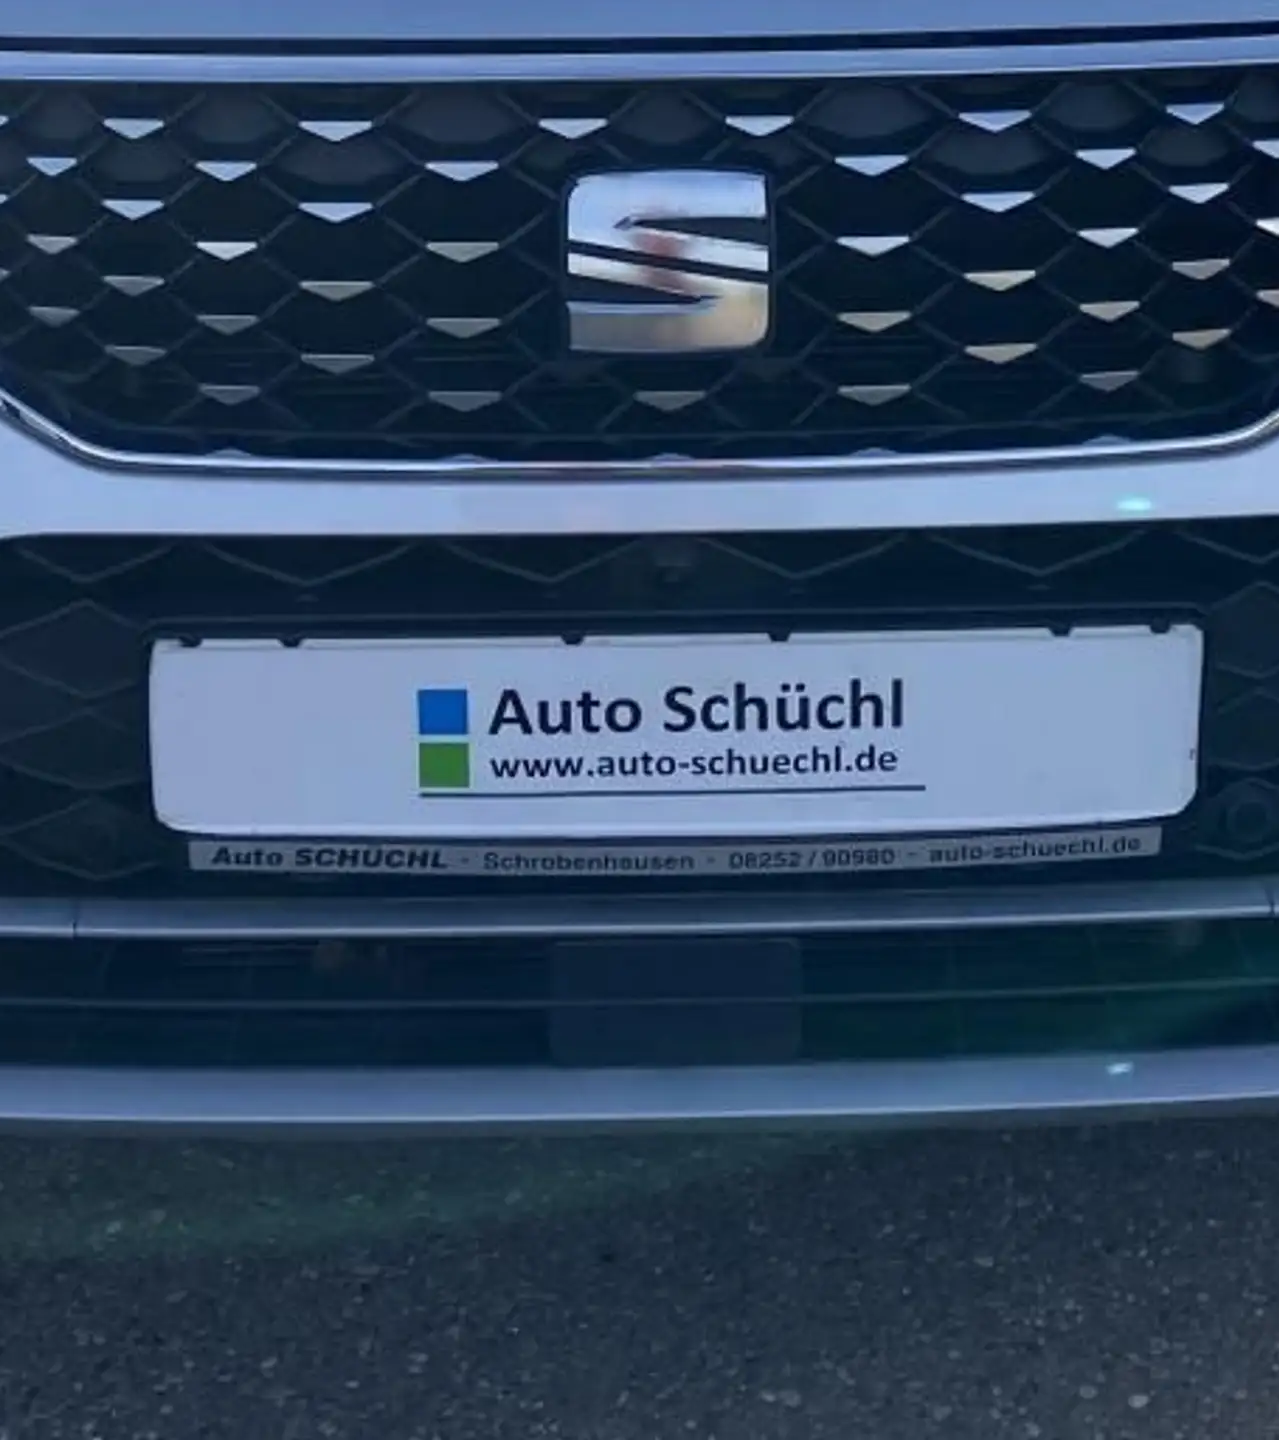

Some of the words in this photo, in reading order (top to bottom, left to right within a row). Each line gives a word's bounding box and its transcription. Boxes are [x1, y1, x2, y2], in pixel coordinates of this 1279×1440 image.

[488, 688, 643, 736] Auto
[663, 678, 904, 733] Schüchl
[489, 744, 899, 778] www.auto-schuechl.de
[211, 845, 283, 866] Auto
[483, 851, 696, 871] Schrobenhausen
[927, 835, 1142, 864] auto-schuechl.de
